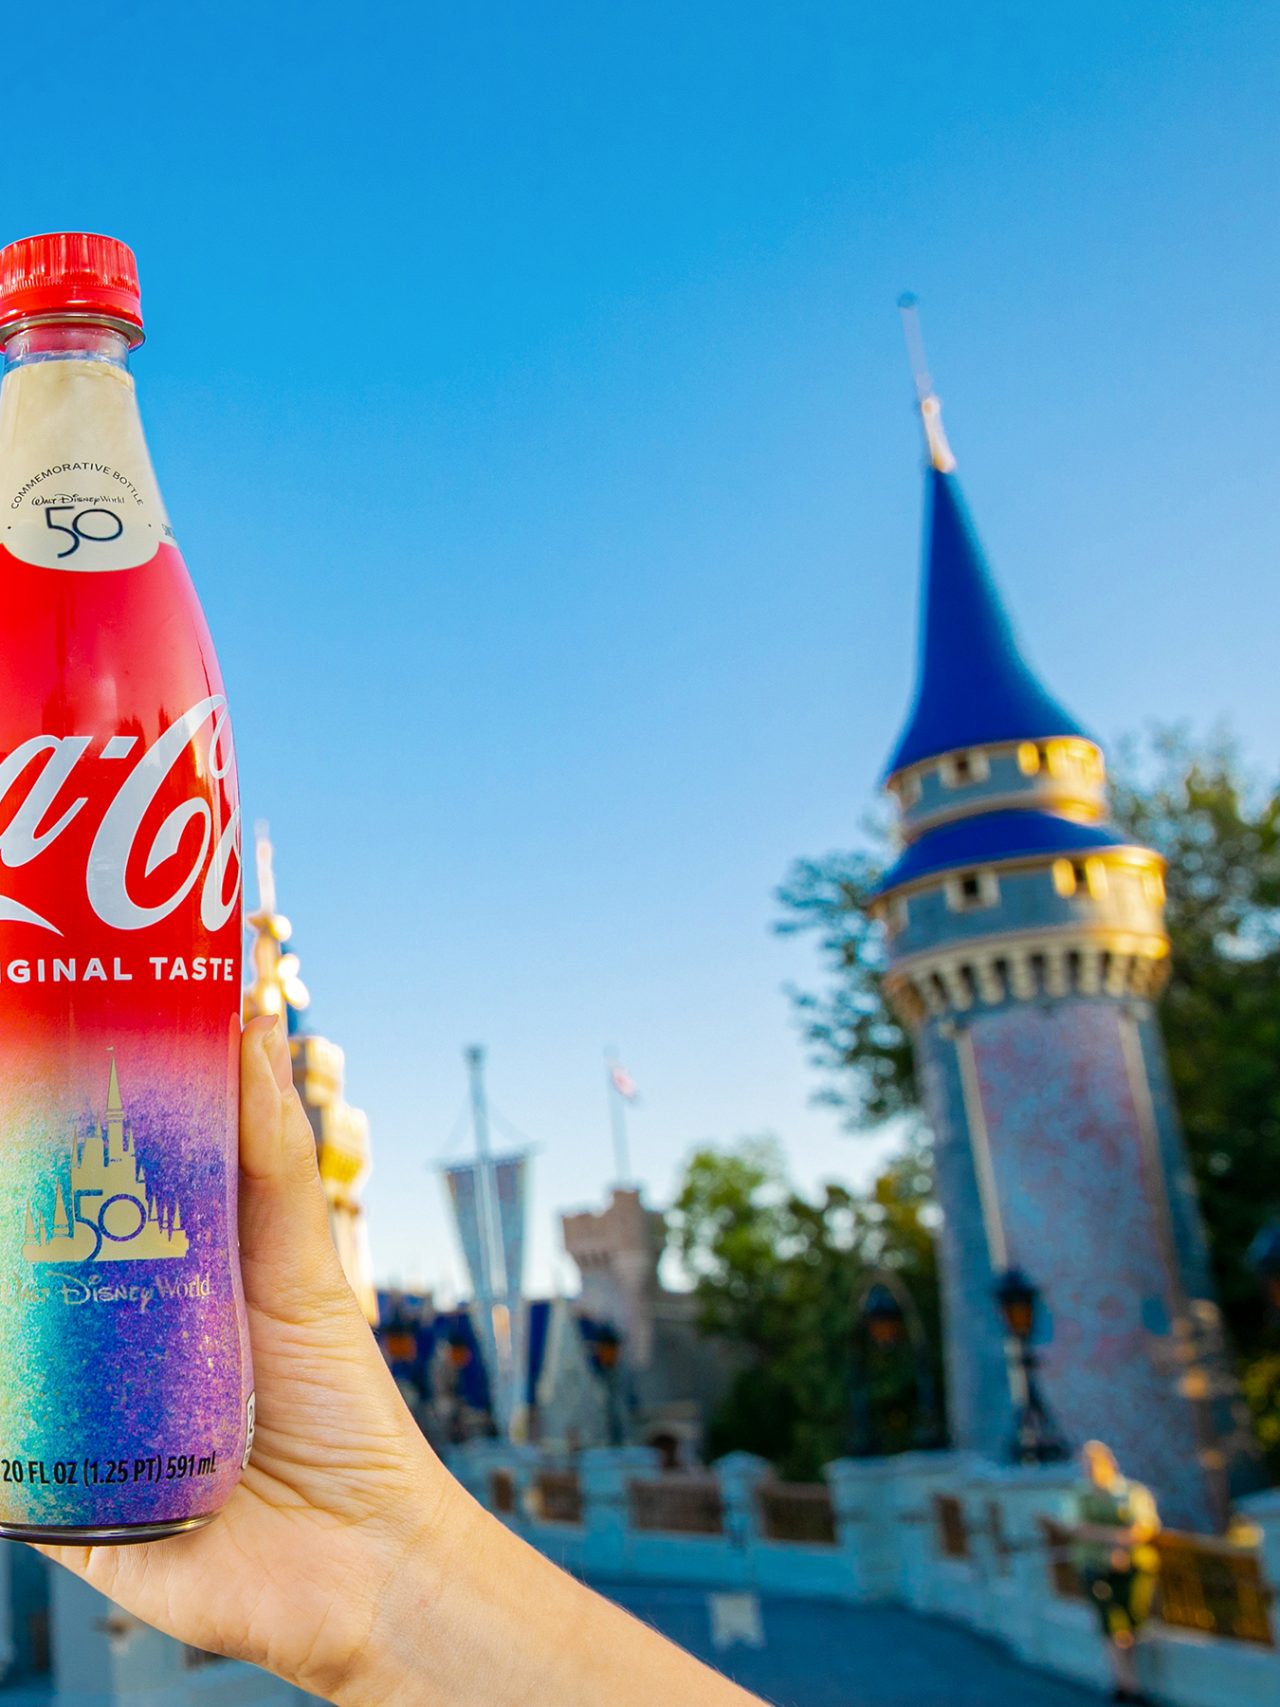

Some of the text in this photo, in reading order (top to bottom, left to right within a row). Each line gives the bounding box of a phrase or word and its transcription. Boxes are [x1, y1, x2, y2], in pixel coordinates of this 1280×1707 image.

[11, 462, 143, 509] COMMEMORATIVE BOTTLE
[54, 493, 100, 505] Disney
[45, 506, 123, 558] 50
[149, 957, 234, 981] TASTE
[74, 1189, 146, 1262] 50
[46, 1271, 152, 1312] Disney
[153, 1273, 210, 1298] World
[1, 1450, 217, 1487] 20 FL OZ (1.25 PT) 591 mL
